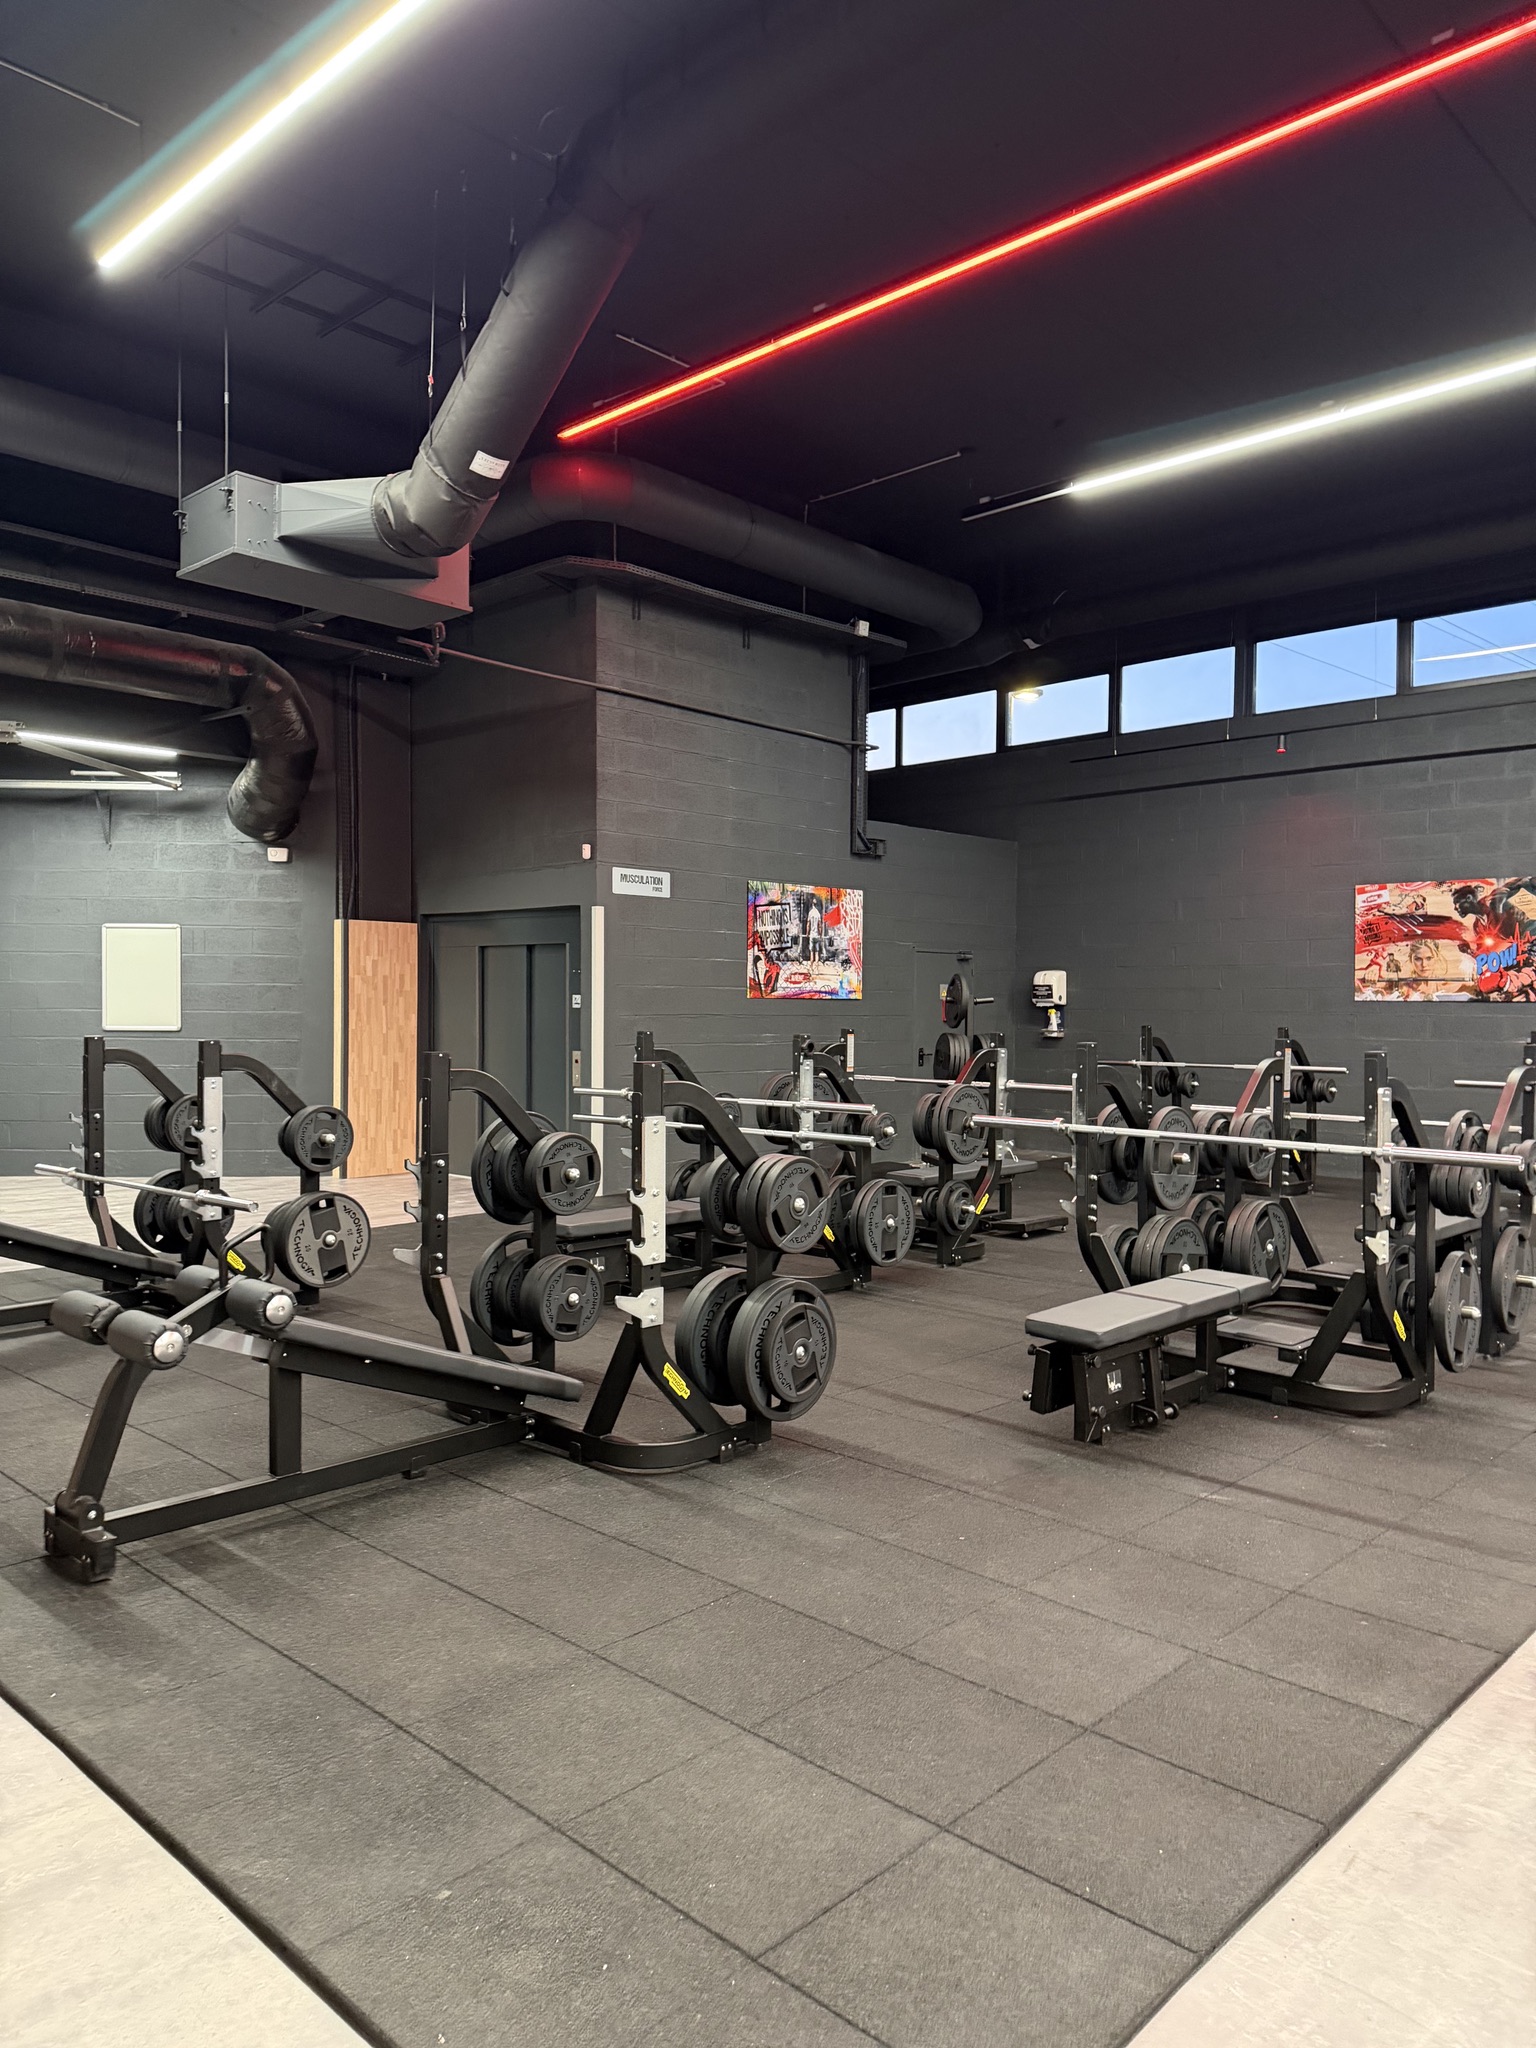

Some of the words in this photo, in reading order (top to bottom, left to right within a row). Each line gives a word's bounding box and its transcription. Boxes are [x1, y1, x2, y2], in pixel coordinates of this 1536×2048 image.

[620, 873, 663, 886] MUSCULATION
[1475, 943, 1518, 976] POW!
[293, 1219, 316, 1277] TECHNOGYM
[342, 1204, 364, 1261] TECHNOGYM
[774, 1337, 793, 1392] TECHNOGYM
